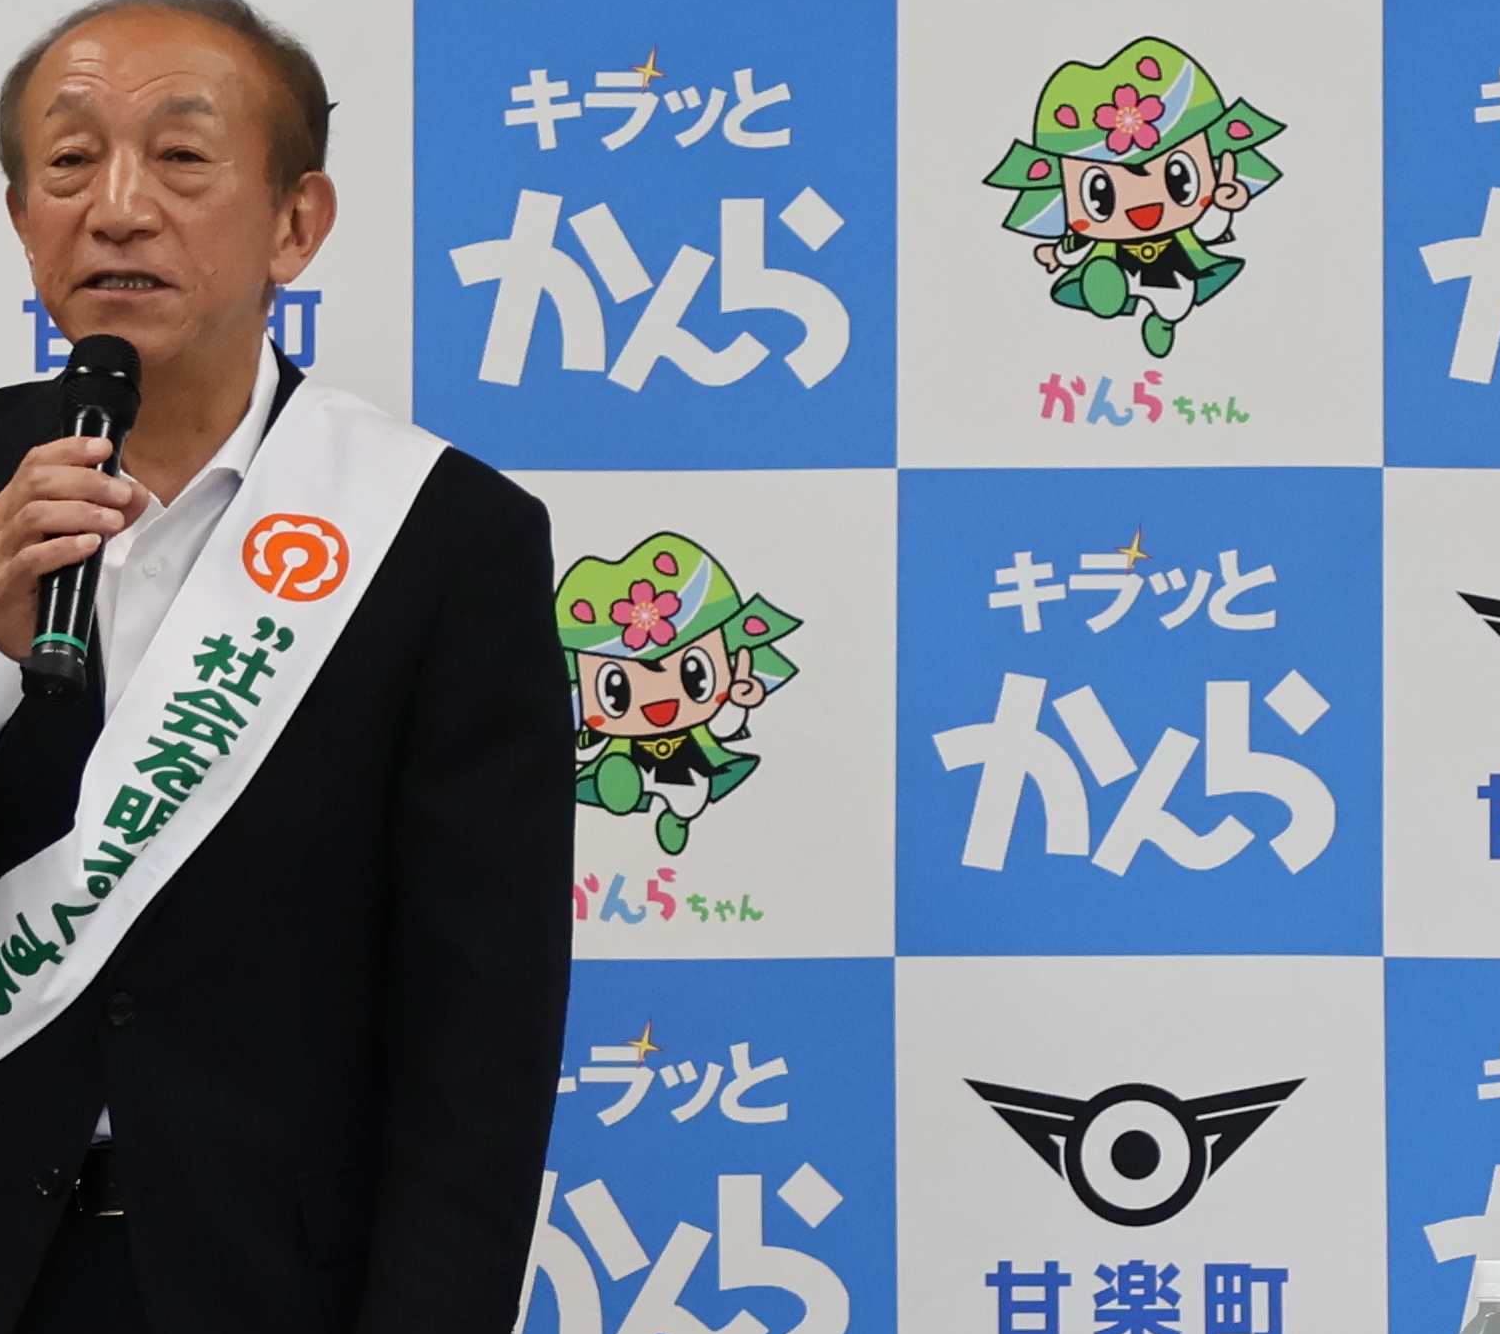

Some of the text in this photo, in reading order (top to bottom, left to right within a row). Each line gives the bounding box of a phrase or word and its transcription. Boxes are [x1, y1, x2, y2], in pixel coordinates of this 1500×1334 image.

[505, 66, 790, 150] キラッと
[450, 188, 849, 391] かんら
[1040, 371, 1247, 425] かんらちゃん
[990, 548, 1276, 632] キラッと
[934, 671, 1335, 875] かんら
[557, 1043, 788, 1127] ラッと
